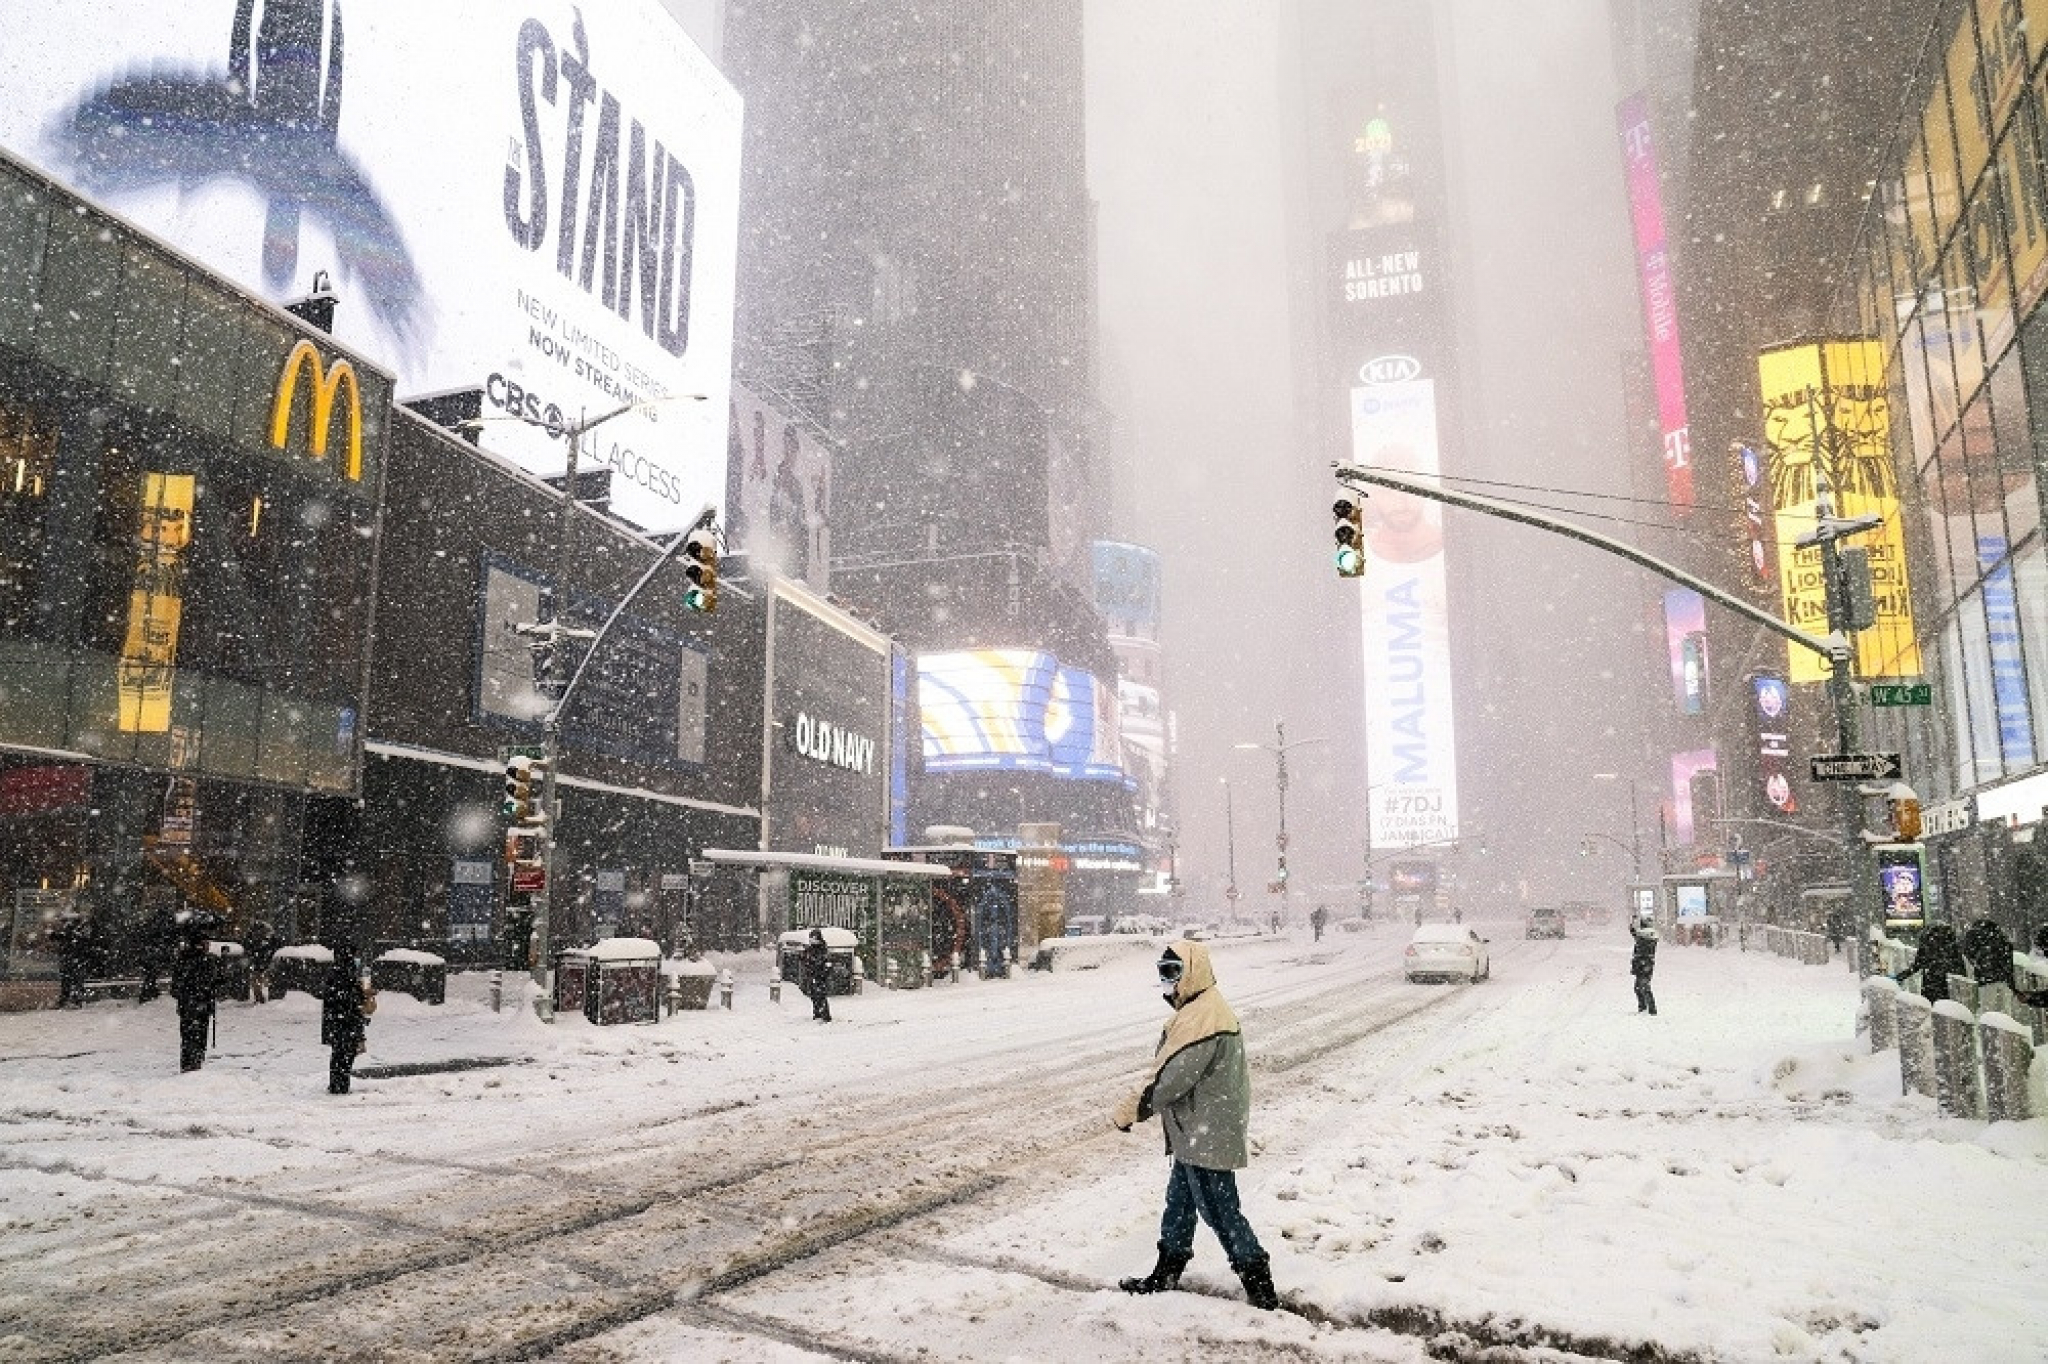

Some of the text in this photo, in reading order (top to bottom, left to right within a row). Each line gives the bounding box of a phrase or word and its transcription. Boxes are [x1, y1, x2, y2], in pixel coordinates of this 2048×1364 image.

[503, 5, 696, 358] STAND
[1345, 251, 1420, 280] ALL-NEW
[1345, 272, 1424, 302] SORENTO
[517, 288, 669, 397] NEW LIMITED SERIES
[528, 325, 659, 422] NOW STREAMING
[1369, 360, 1411, 381] KIA
[486, 372, 541, 421] CBS
[566, 424, 681, 505] LL ACCESS
[1787, 597, 1826, 625] KIN
[1384, 577, 1428, 783] MALUMA
[1873, 687, 1887, 704] W
[1894, 687, 1912, 703] 45
[797, 712, 875, 775] OLD NAVY
[1383, 796, 1443, 814] #7DJ
[1397, 815, 1426, 828] DIAS
[797, 879, 869, 894] DISCOVER
